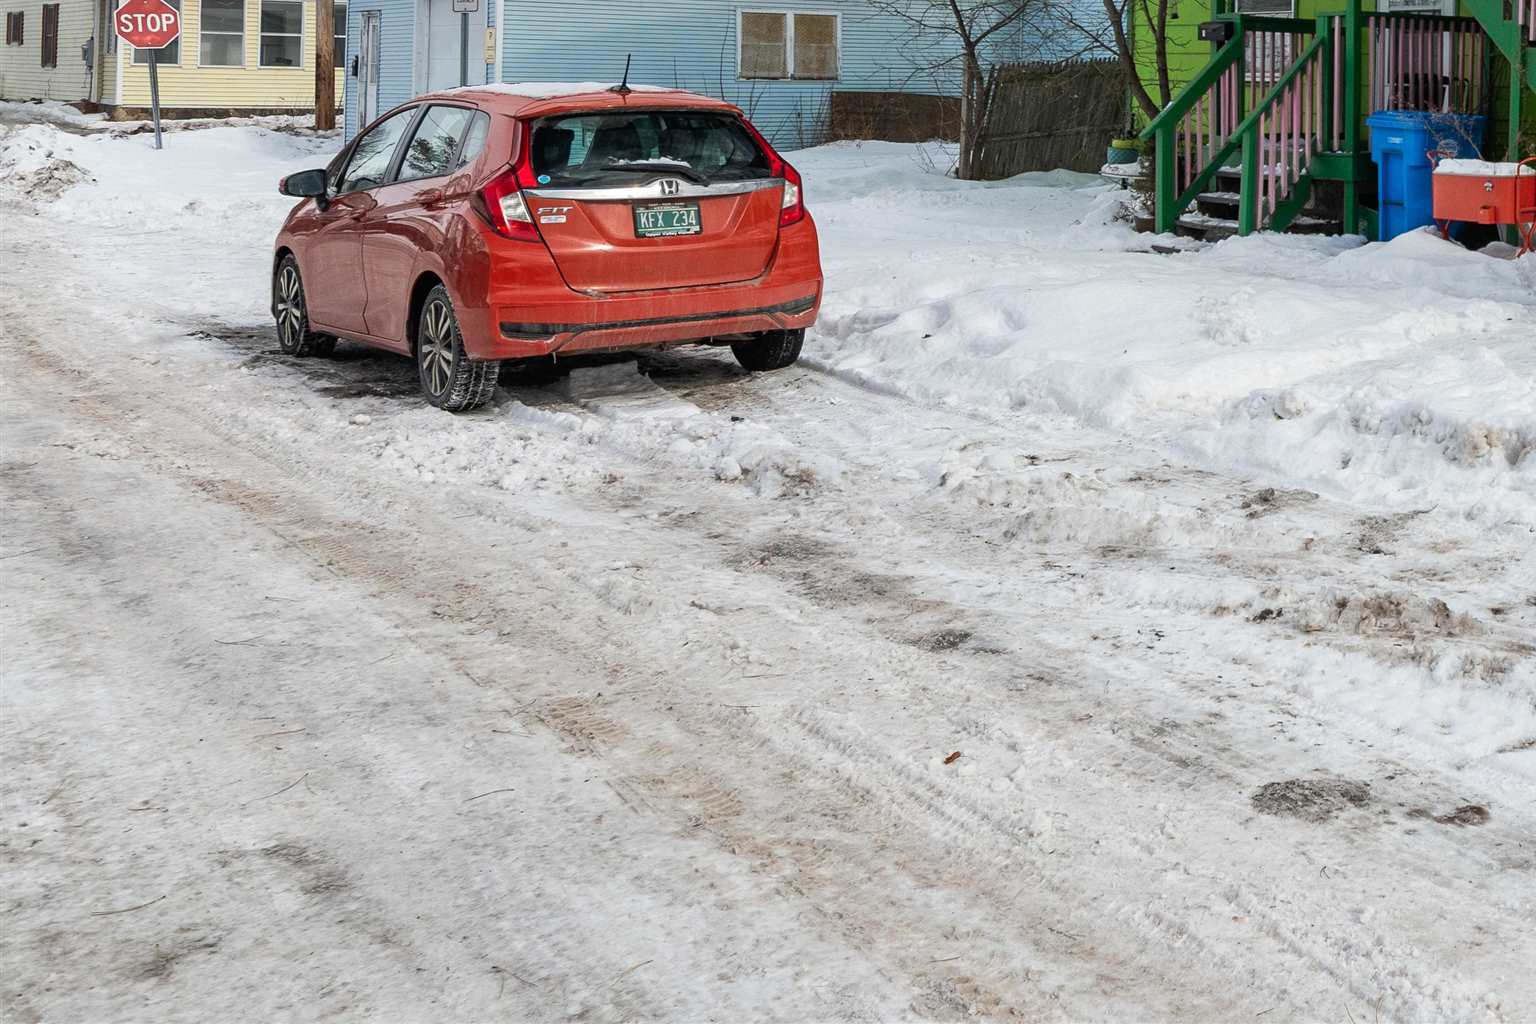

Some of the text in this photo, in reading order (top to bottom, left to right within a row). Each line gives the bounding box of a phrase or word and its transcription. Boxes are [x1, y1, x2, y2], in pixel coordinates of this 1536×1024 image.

[120, 13, 174, 33] STOP
[536, 206, 576, 215] FIT
[640, 210, 696, 228] KFX 234
